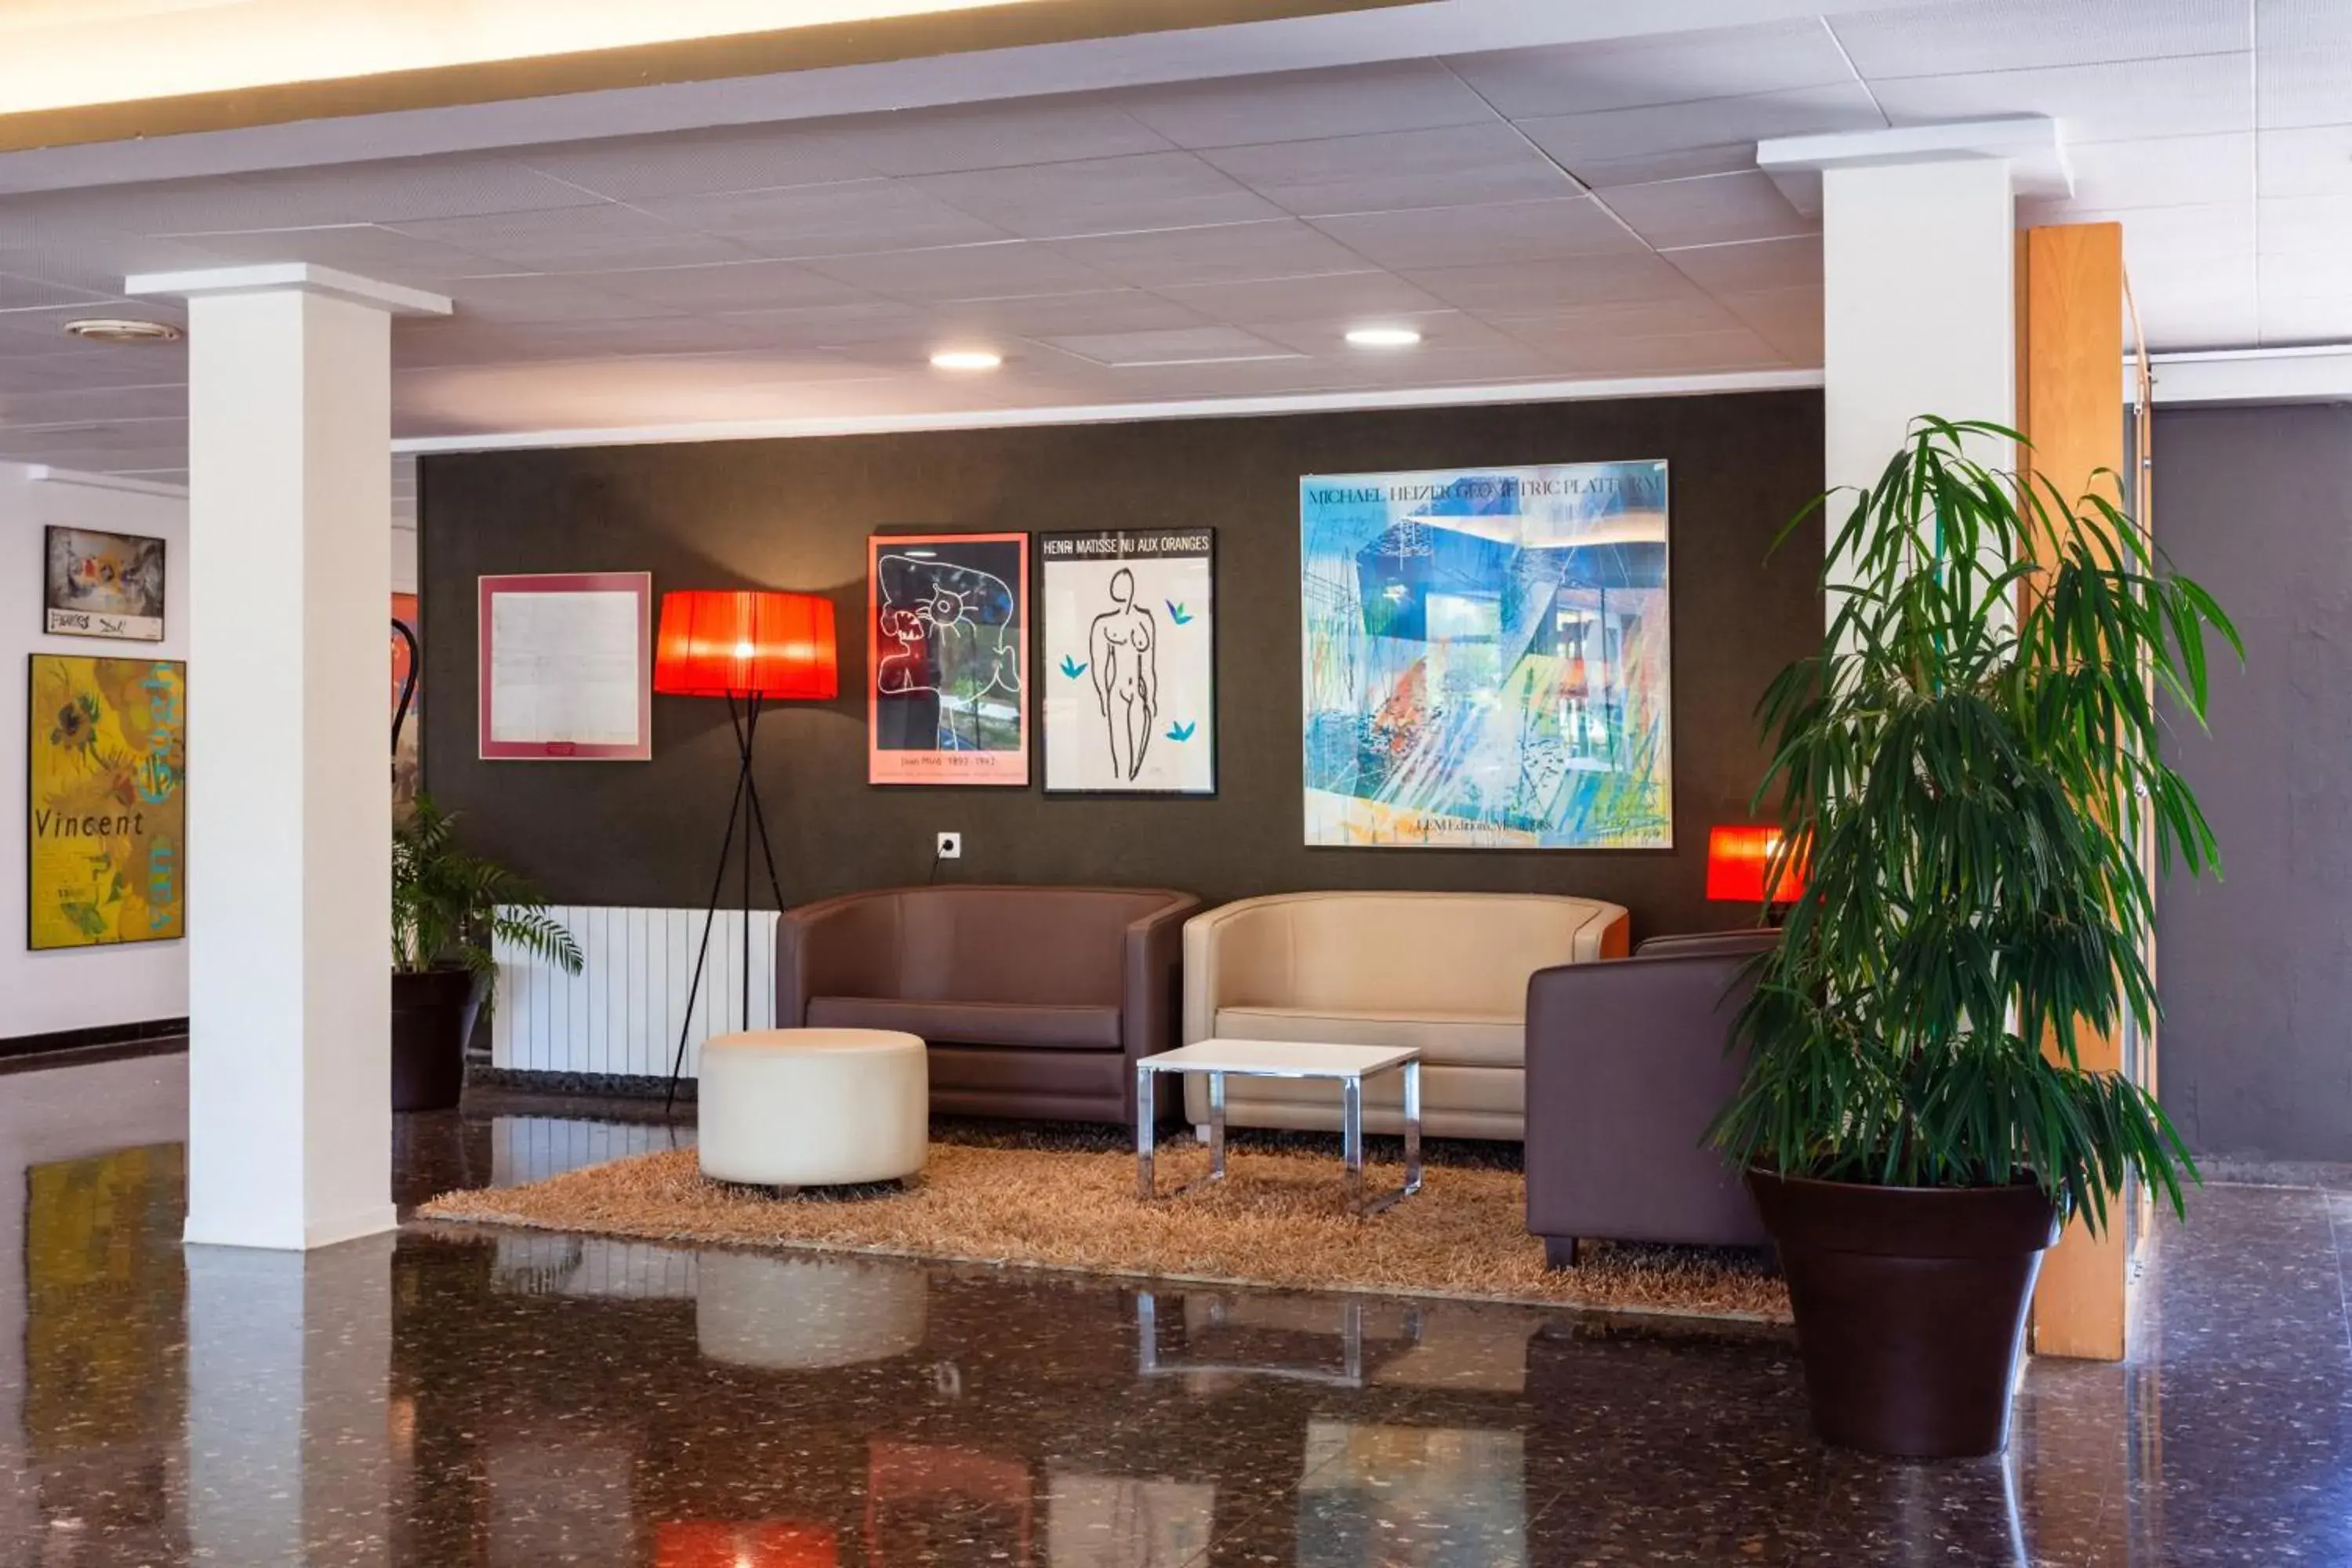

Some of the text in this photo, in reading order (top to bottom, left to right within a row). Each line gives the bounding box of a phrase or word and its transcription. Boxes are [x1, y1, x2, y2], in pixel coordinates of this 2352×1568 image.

[1308, 487, 1385, 506] MICHAEL
[1389, 482, 1452, 502] HEIZER
[1043, 535, 1210, 555] HENRI MATISSE NU AUX ORANGES
[35, 808, 143, 838] Vincent
